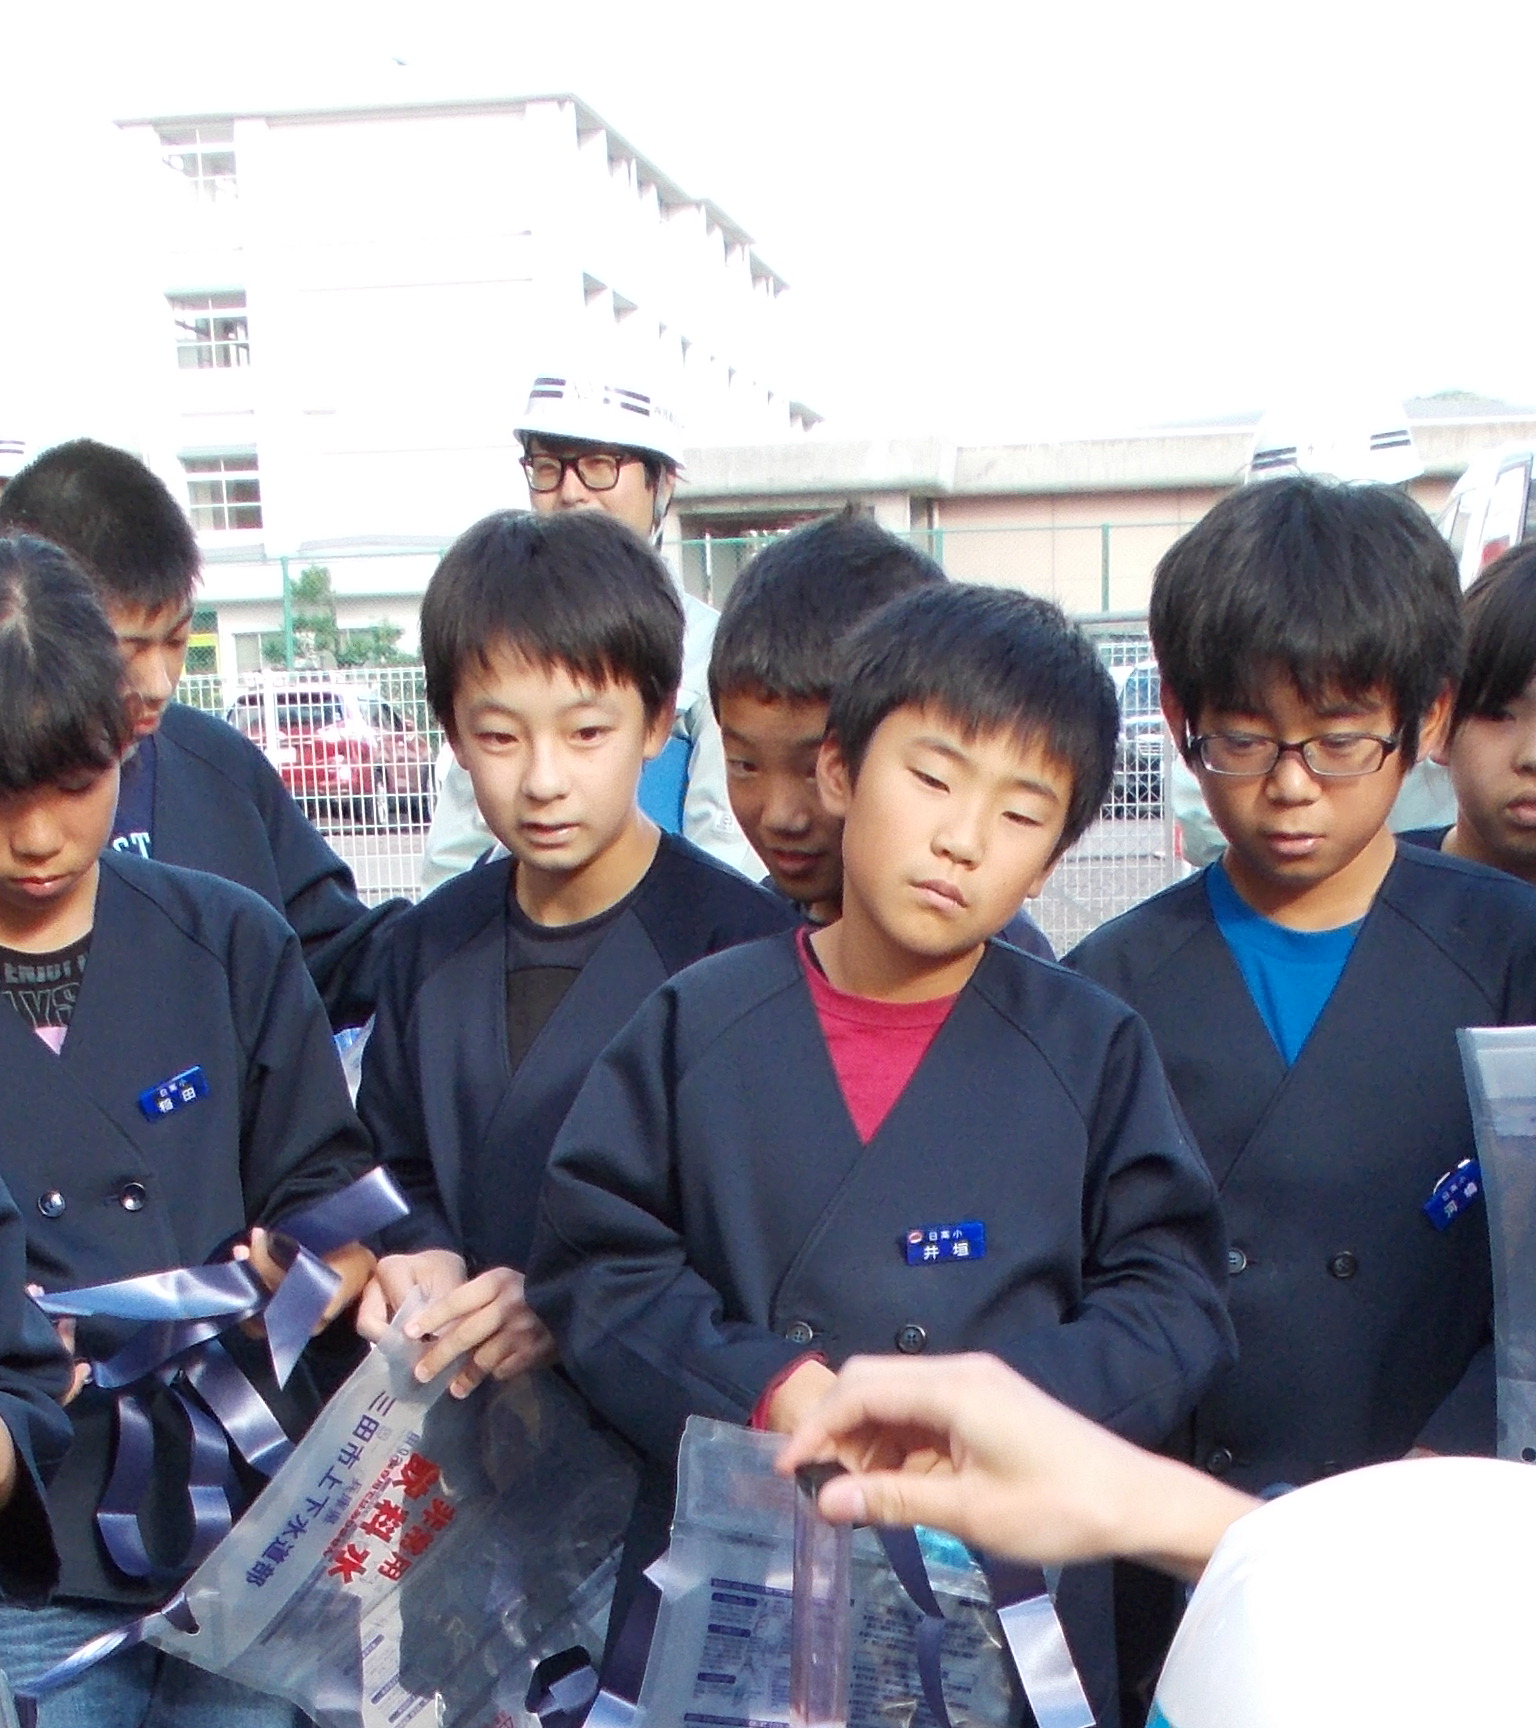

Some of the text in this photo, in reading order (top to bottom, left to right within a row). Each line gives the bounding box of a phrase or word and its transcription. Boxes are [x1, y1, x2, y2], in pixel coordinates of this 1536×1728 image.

[923, 1242, 970, 1260] 井垣
[246, 1390, 397, 1587] 三田市上下水道部
[327, 1452, 441, 1584] 飲料水
